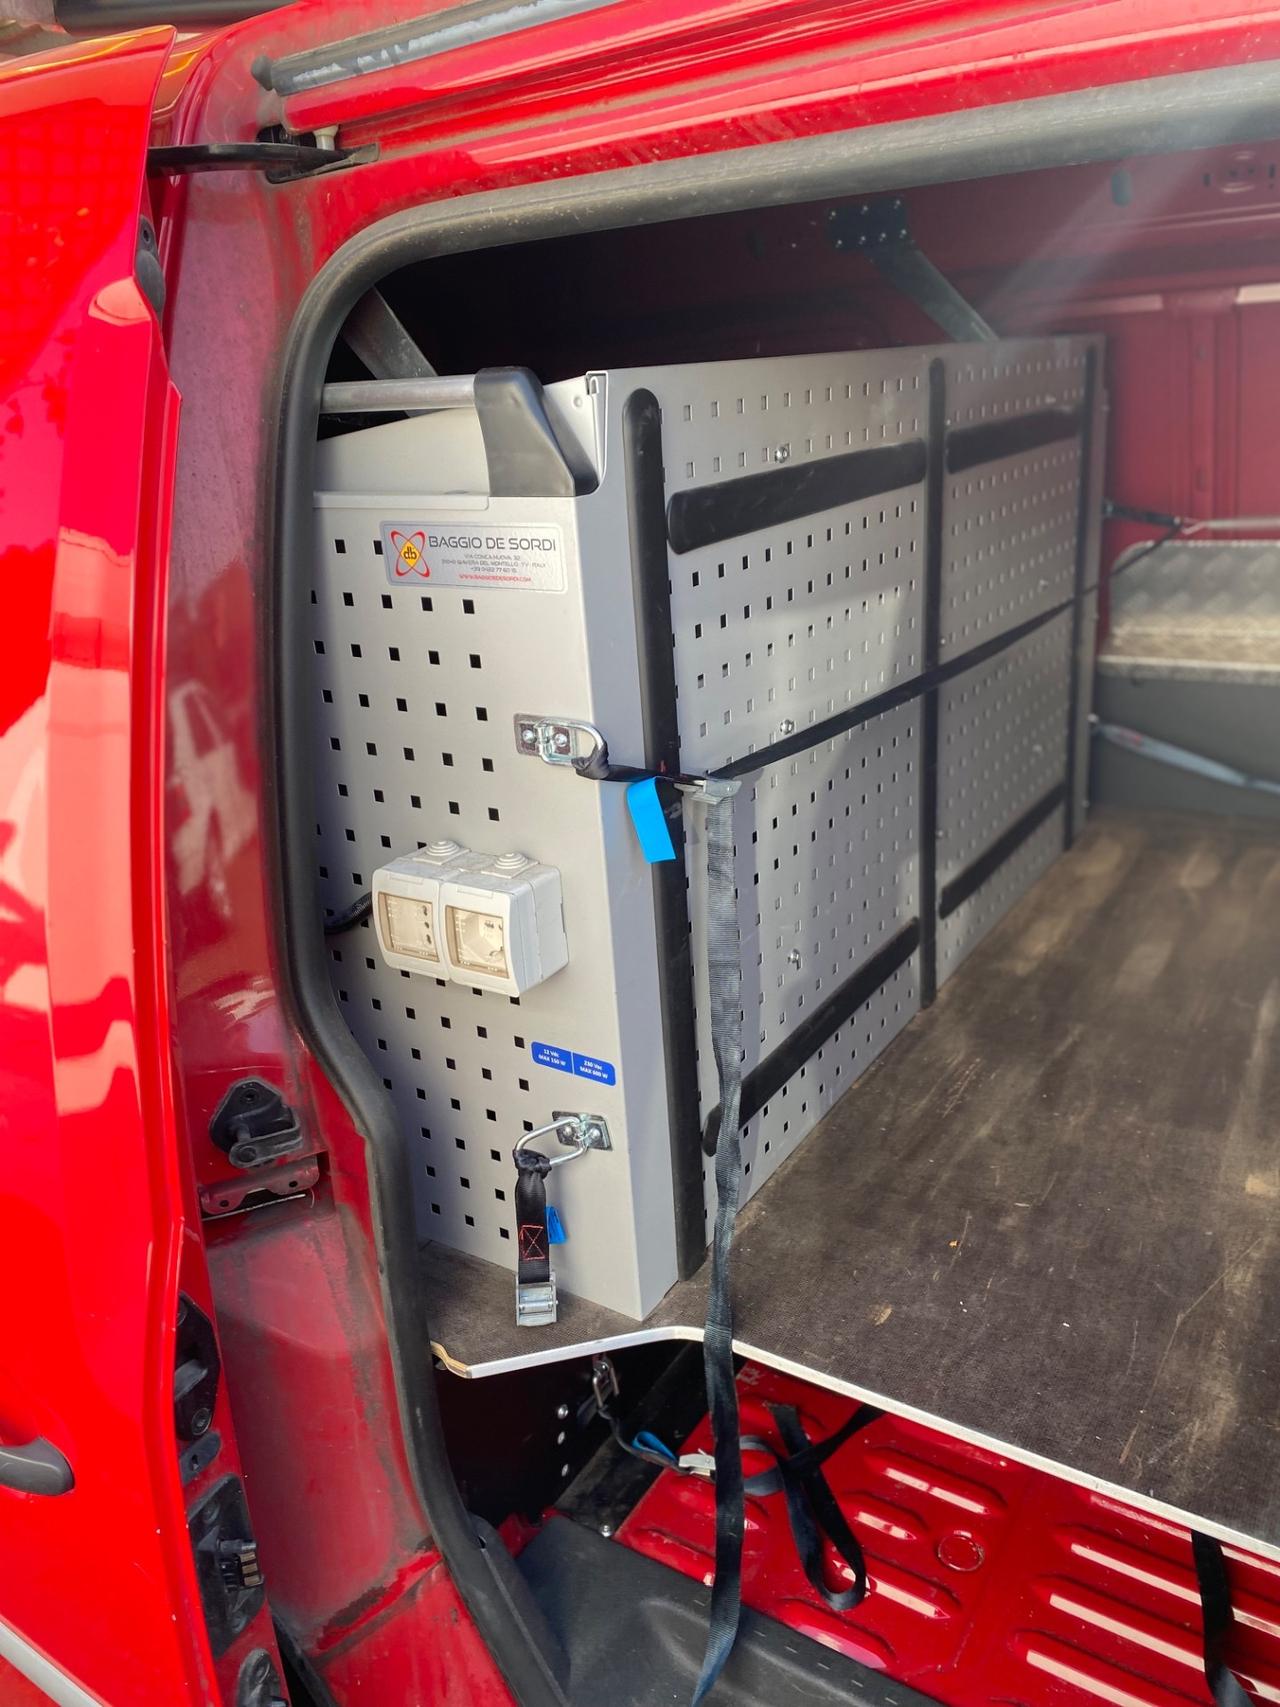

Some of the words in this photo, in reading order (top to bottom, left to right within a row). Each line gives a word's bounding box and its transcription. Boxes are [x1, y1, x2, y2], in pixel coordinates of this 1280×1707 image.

[428, 535, 483, 549] BAGGIO
[486, 537, 506, 550] DE
[509, 538, 556, 551] SORDI
[580, 1066, 592, 1074] MAX
